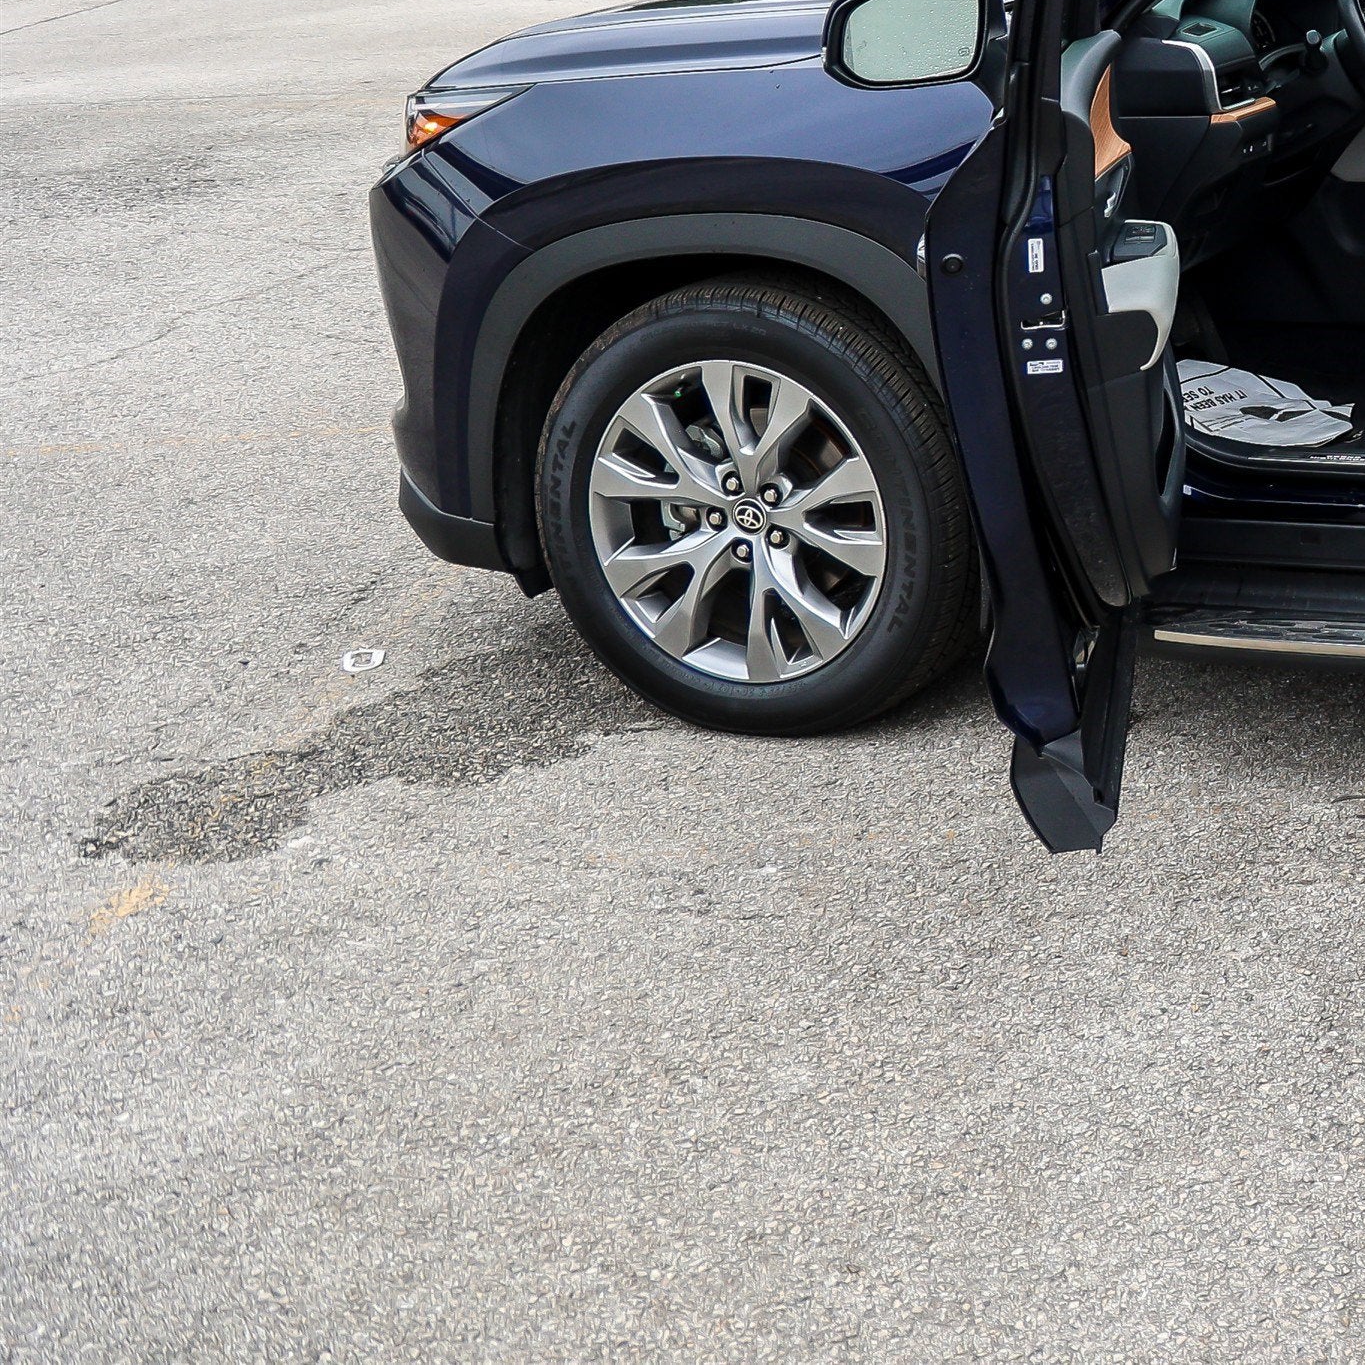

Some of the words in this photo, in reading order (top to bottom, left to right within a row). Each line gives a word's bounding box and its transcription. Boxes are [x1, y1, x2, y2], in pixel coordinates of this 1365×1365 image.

[1197, 386, 1215, 396] TO
[1234, 390, 1248, 400] IT
[1215, 392, 1237, 405] HAS
[1189, 398, 1217, 412] BEEN
